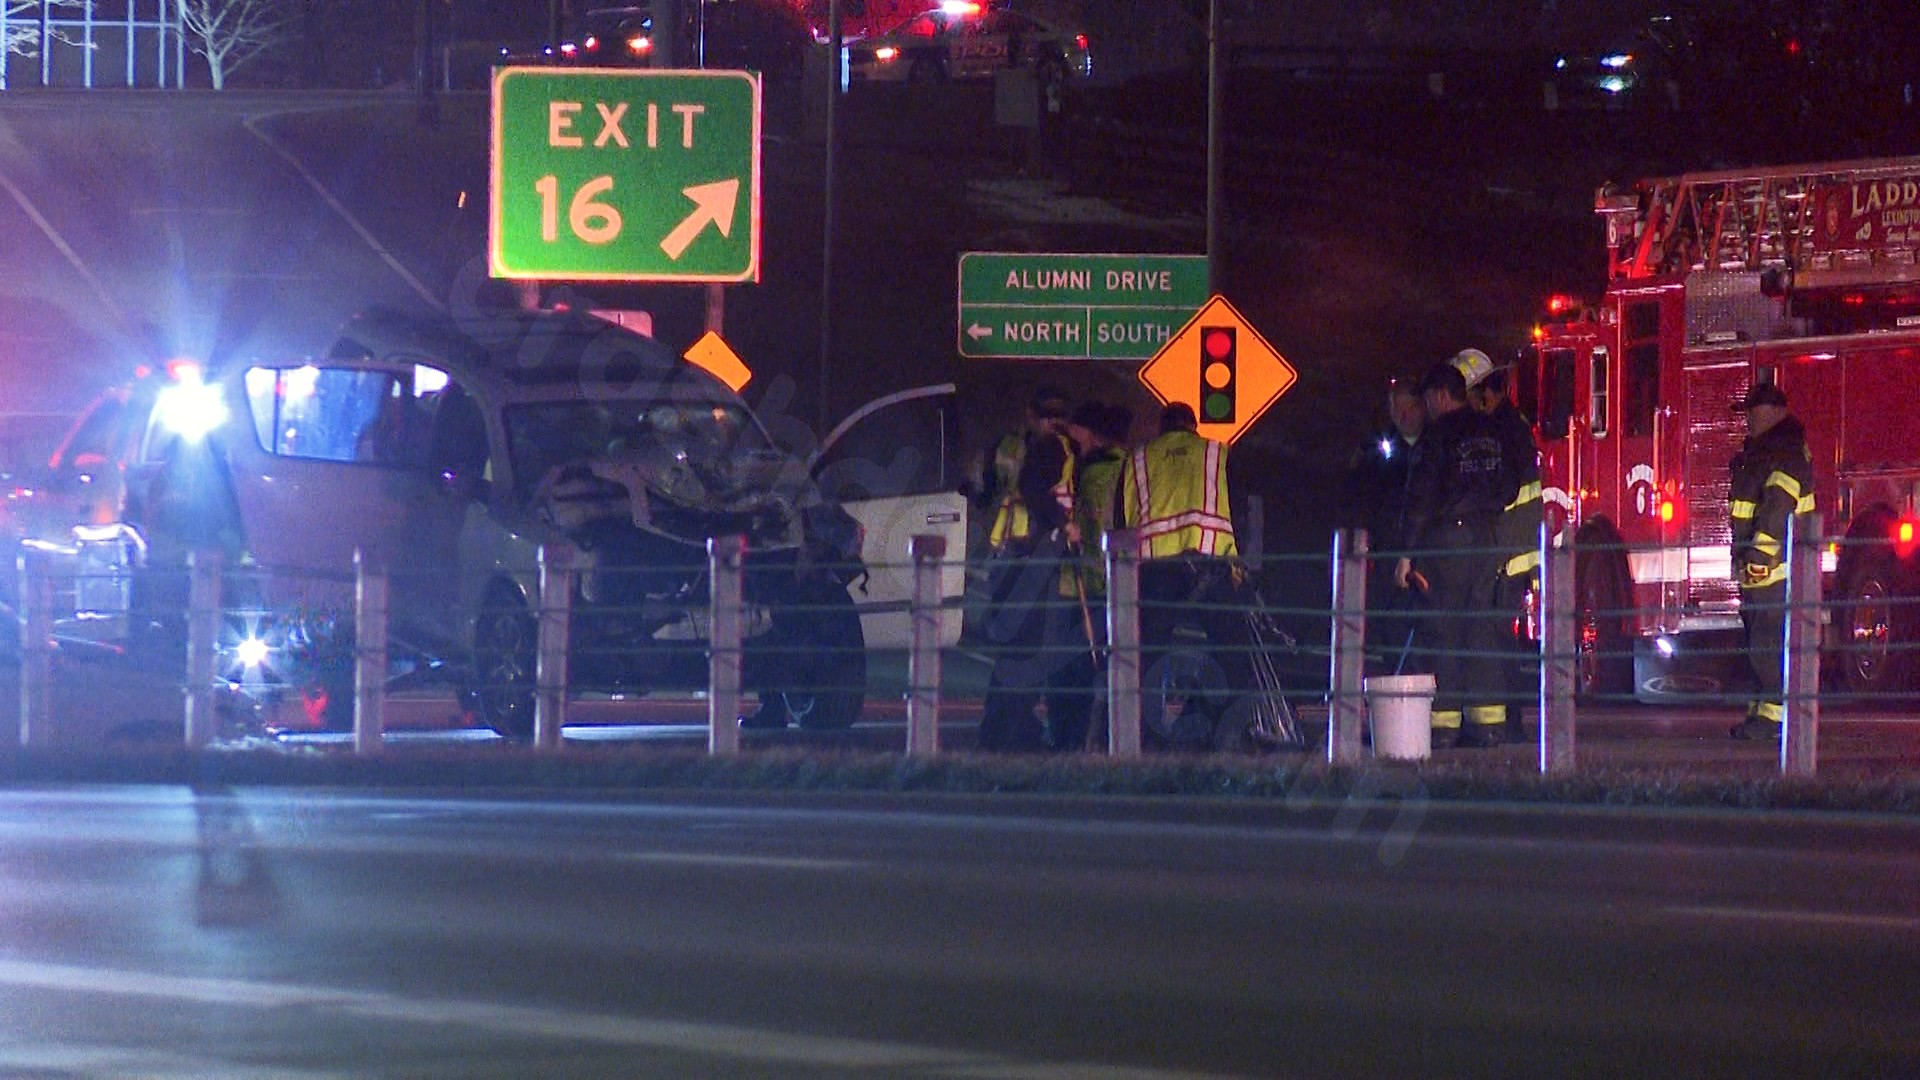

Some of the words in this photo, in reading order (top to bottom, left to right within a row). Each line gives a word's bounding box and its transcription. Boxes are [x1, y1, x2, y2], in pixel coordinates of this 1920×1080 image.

[549, 102, 705, 148] EXIT
[535, 174, 623, 244] 16
[1851, 180, 1920, 219] LADD
[1005, 269, 1091, 290] ALUMNI
[1106, 270, 1172, 292] DRIVE
[1004, 320, 1080, 343] NORTH
[1097, 322, 1171, 344] SOUTH
